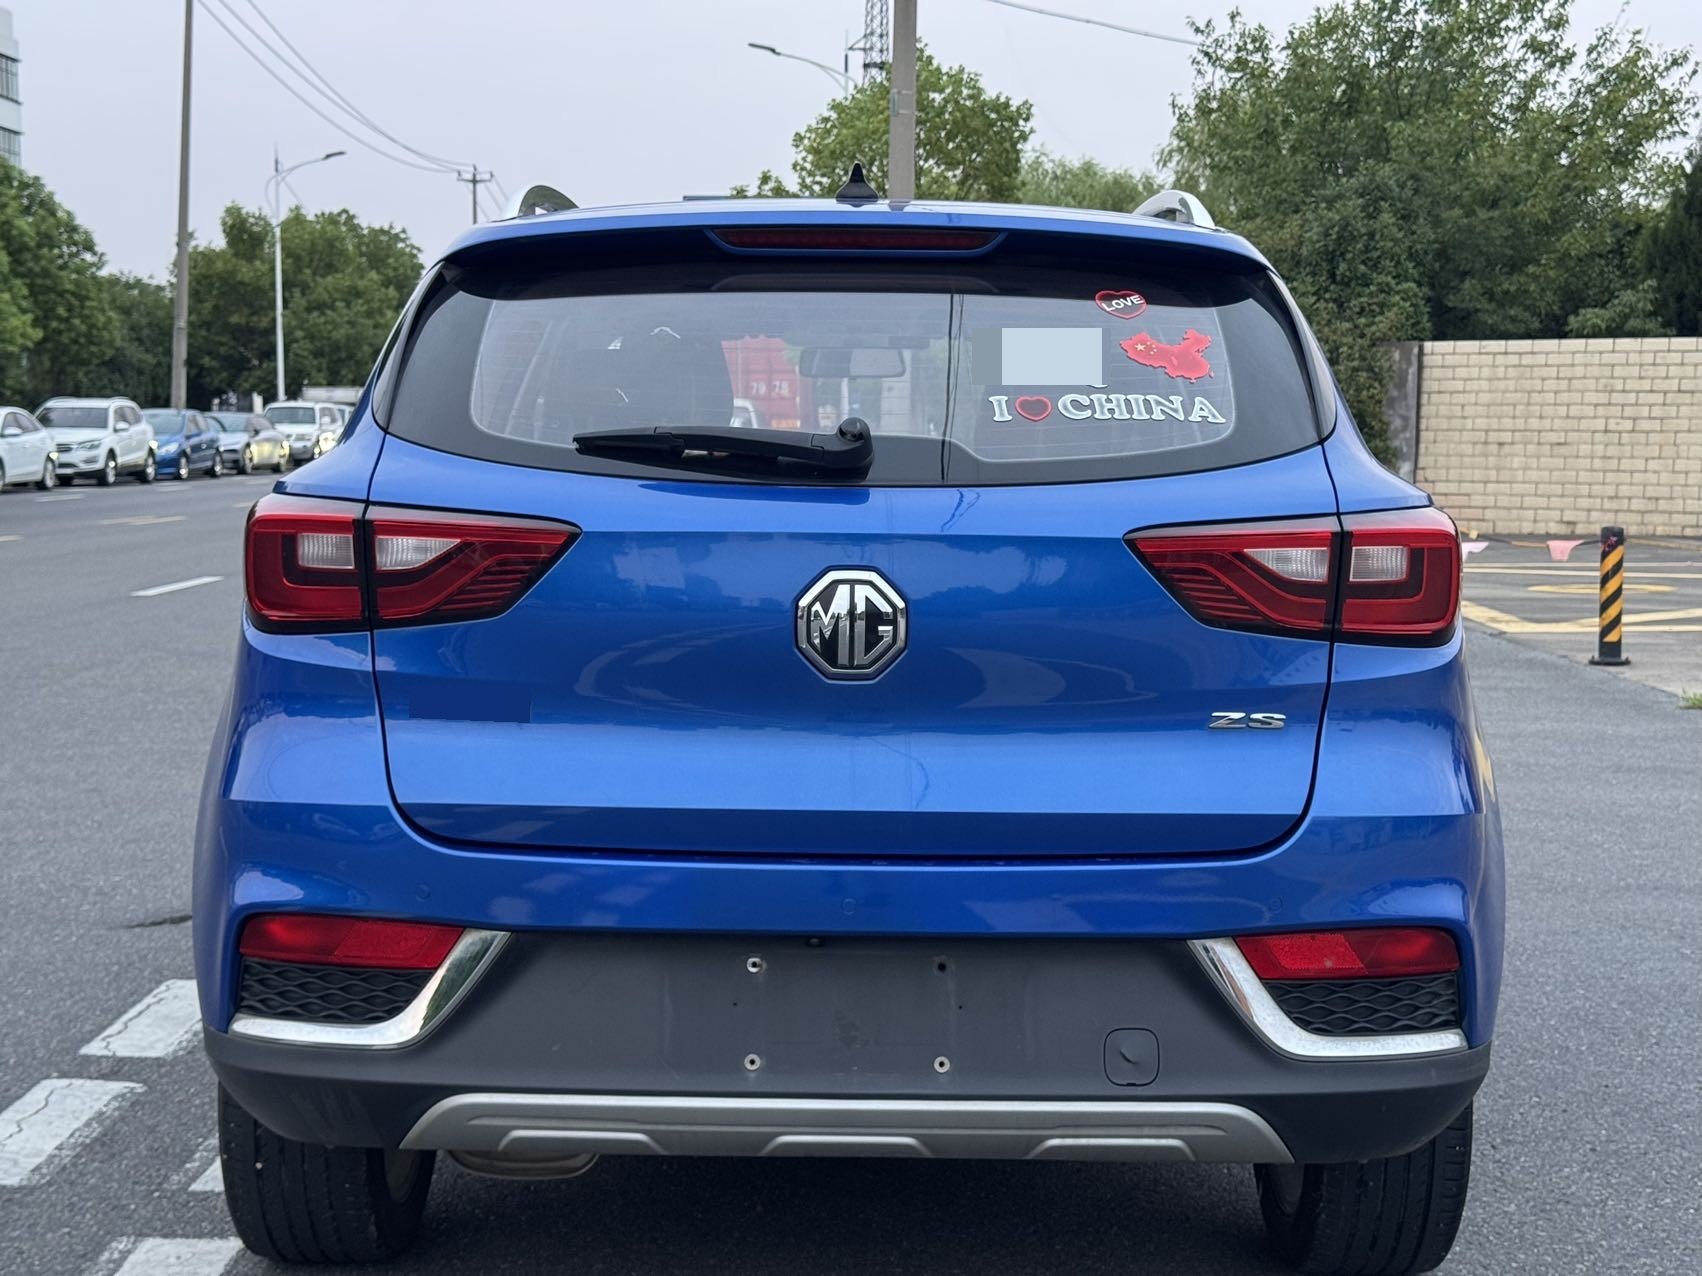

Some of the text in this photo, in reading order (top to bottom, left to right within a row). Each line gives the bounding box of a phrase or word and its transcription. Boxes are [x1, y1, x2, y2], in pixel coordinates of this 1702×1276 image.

[1102, 294, 1145, 312] LOVE
[988, 394, 1226, 424] I CHINA
[811, 584, 893, 667] MG
[1209, 712, 1287, 728] ZS
